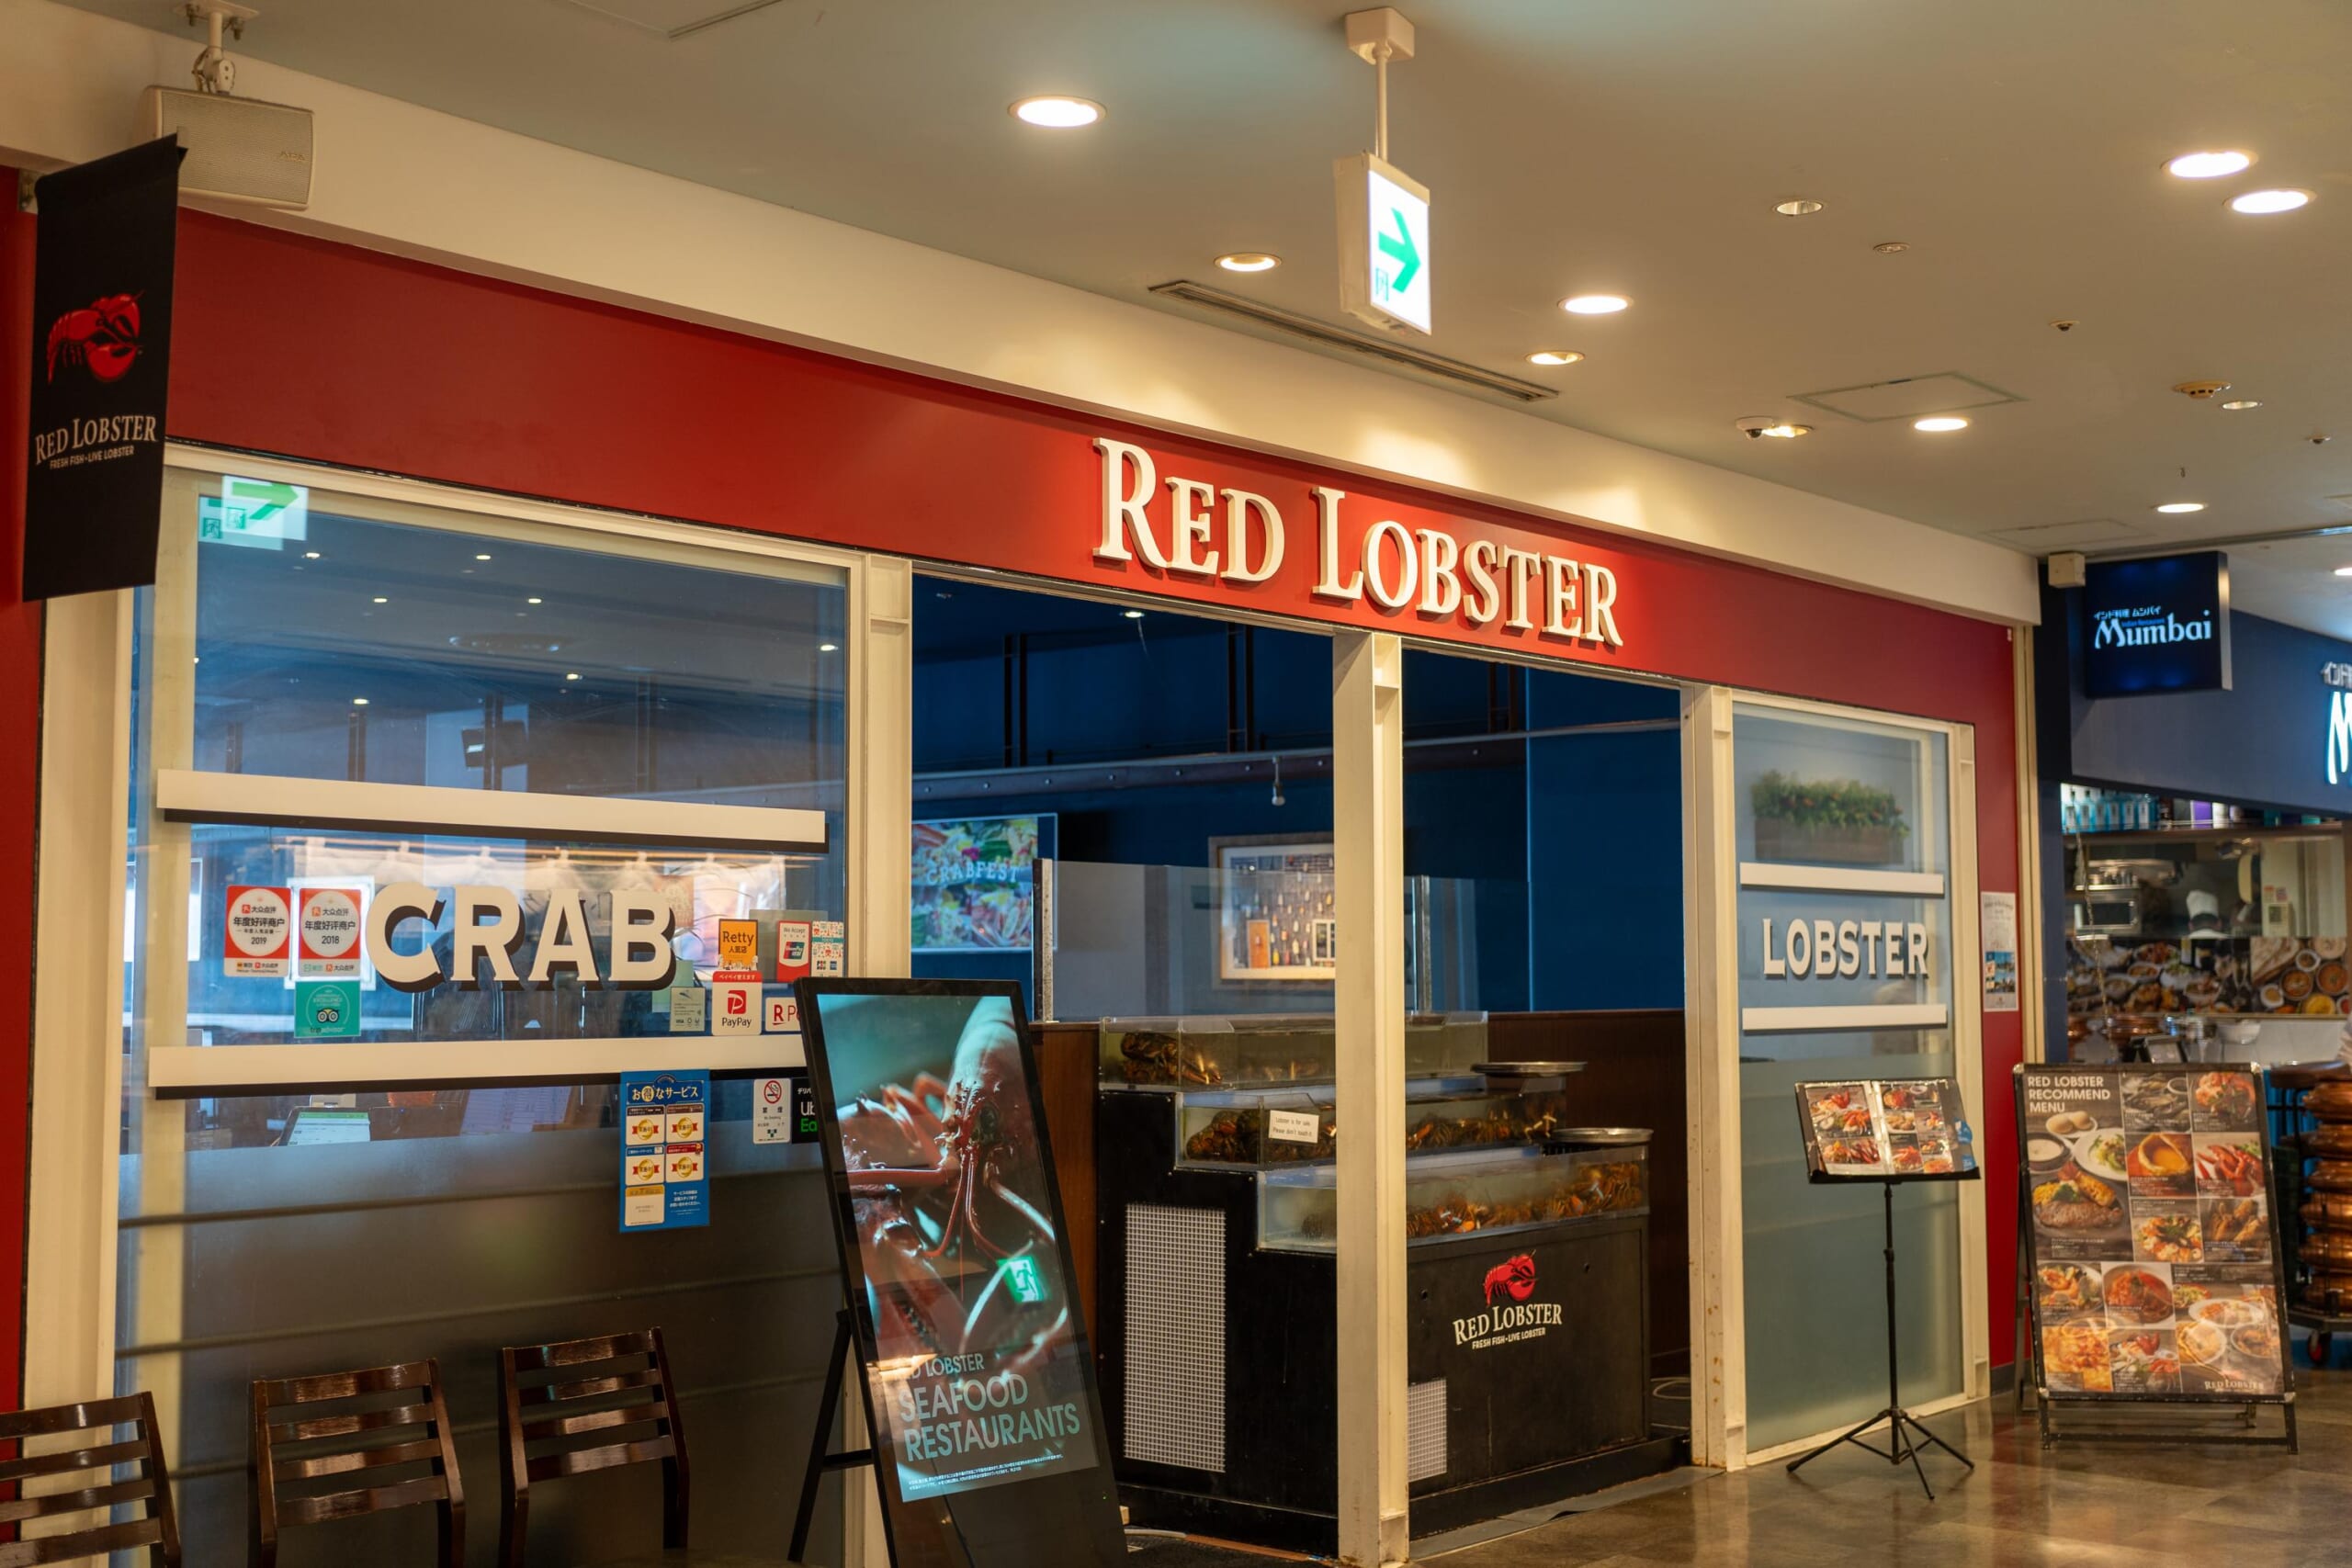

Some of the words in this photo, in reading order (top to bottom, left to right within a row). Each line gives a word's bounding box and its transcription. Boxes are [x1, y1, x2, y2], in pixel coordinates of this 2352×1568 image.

[35, 427, 70, 465] RED
[72, 415, 159, 449] LOBSTER
[50, 457, 69, 469] FRESH
[104, 446, 134, 459] LOBSTER
[1093, 437, 1285, 582] RED
[1312, 486, 1623, 647] LOBSTER
[2095, 609, 2211, 649] Mumbai
[926, 861, 1020, 886] CRABFEST
[233, 917, 285, 927] 年度好评商户
[304, 920, 356, 931] 年度好评商户
[322, 935, 340, 944] 2018
[366, 882, 674, 991] CRAB
[722, 931, 754, 946] Retty
[1762, 918, 1929, 978] LOBSTER
[721, 1018, 752, 1029] PayPay
[2028, 1076, 2051, 1087] RED
[2054, 1076, 2104, 1088] LOBSTER
[632, 1086, 698, 1102] お得なサービス
[2028, 1089, 2110, 1100] RECOMMEND
[2030, 1101, 2065, 1113] MENU
[1453, 1314, 1490, 1346] RED
[1492, 1303, 1562, 1332] LOBSTER
[1472, 1337, 1491, 1349] FRESH
[1521, 1327, 1545, 1340] LOBSTER
[925, 1353, 985, 1378] LOBSTER
[898, 1374, 1028, 1423] SEAFOOD
[904, 1403, 1080, 1462] RESTAURANTS
